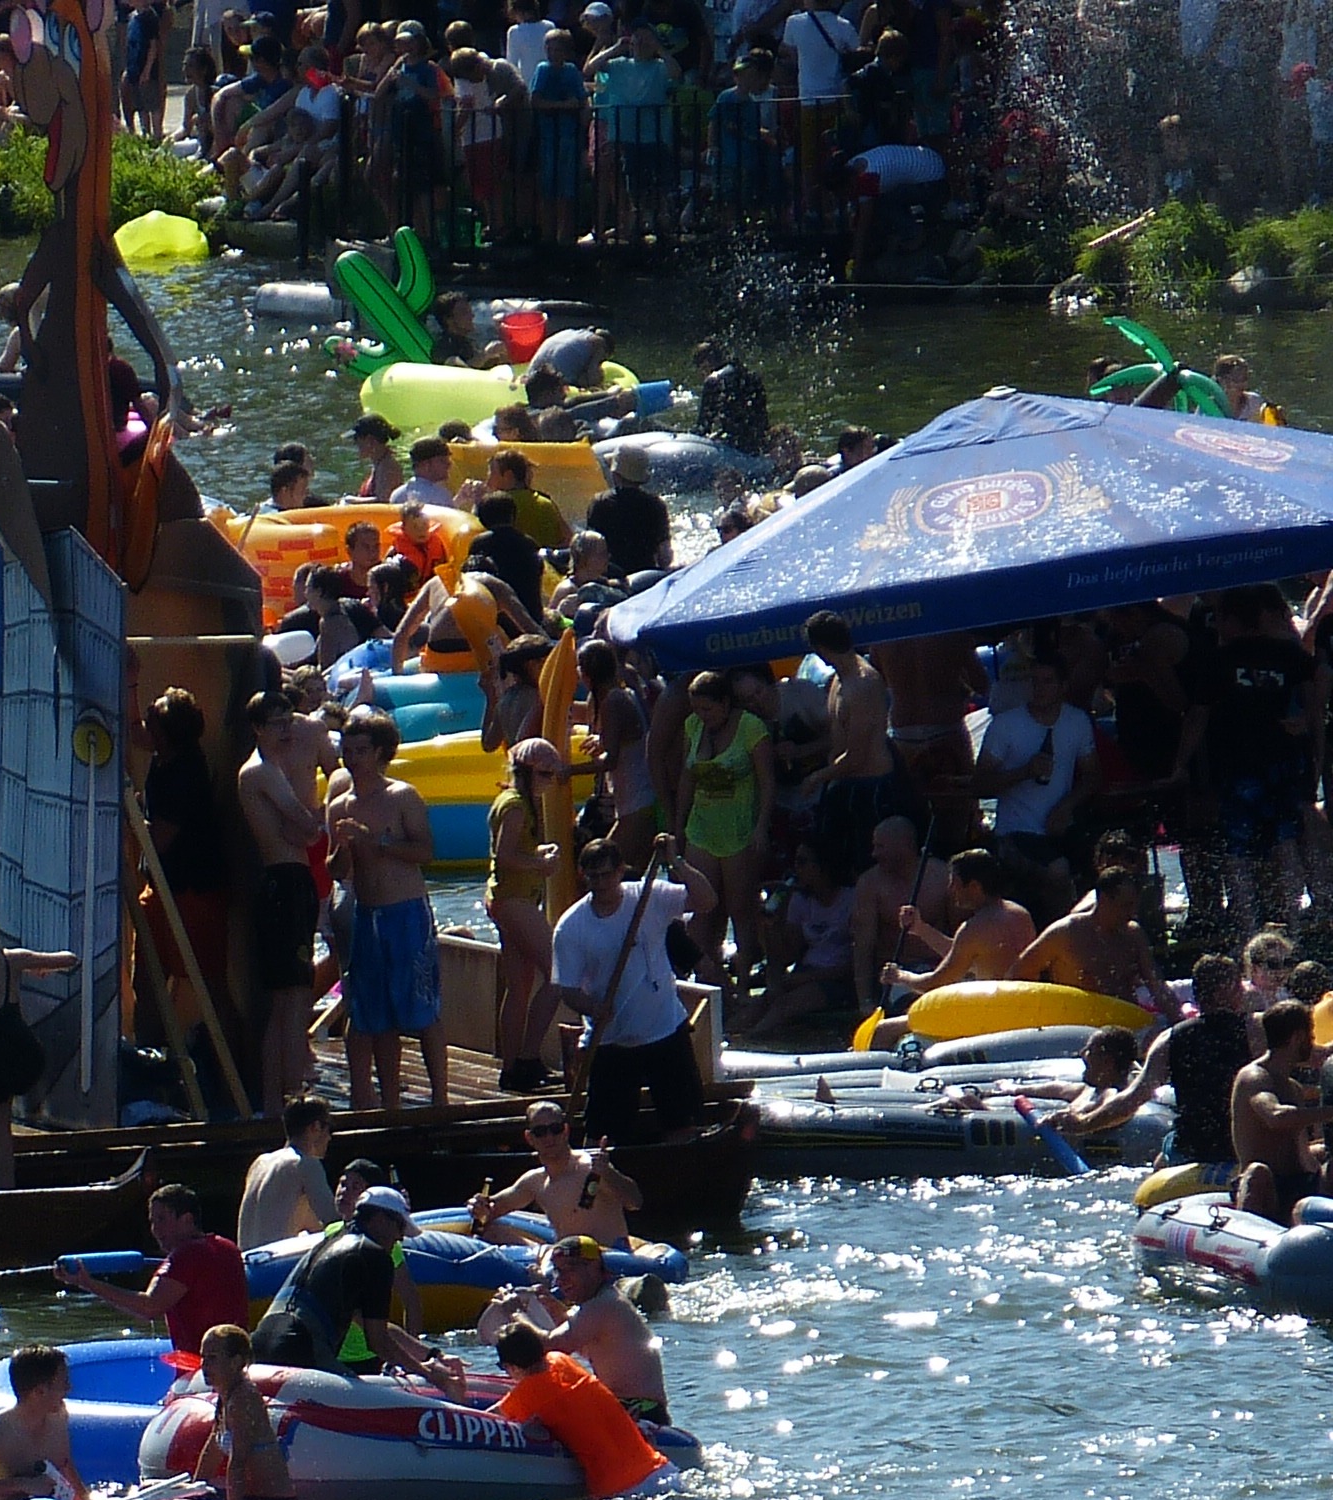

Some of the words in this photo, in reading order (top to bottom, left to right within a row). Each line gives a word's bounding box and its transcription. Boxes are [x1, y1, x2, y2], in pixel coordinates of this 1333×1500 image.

[1067, 571, 1100, 589] Das
[1197, 545, 1284, 569] Vergnügen
[705, 620, 807, 652] Günzbur
[418, 1409, 527, 1448] CLIPPER
